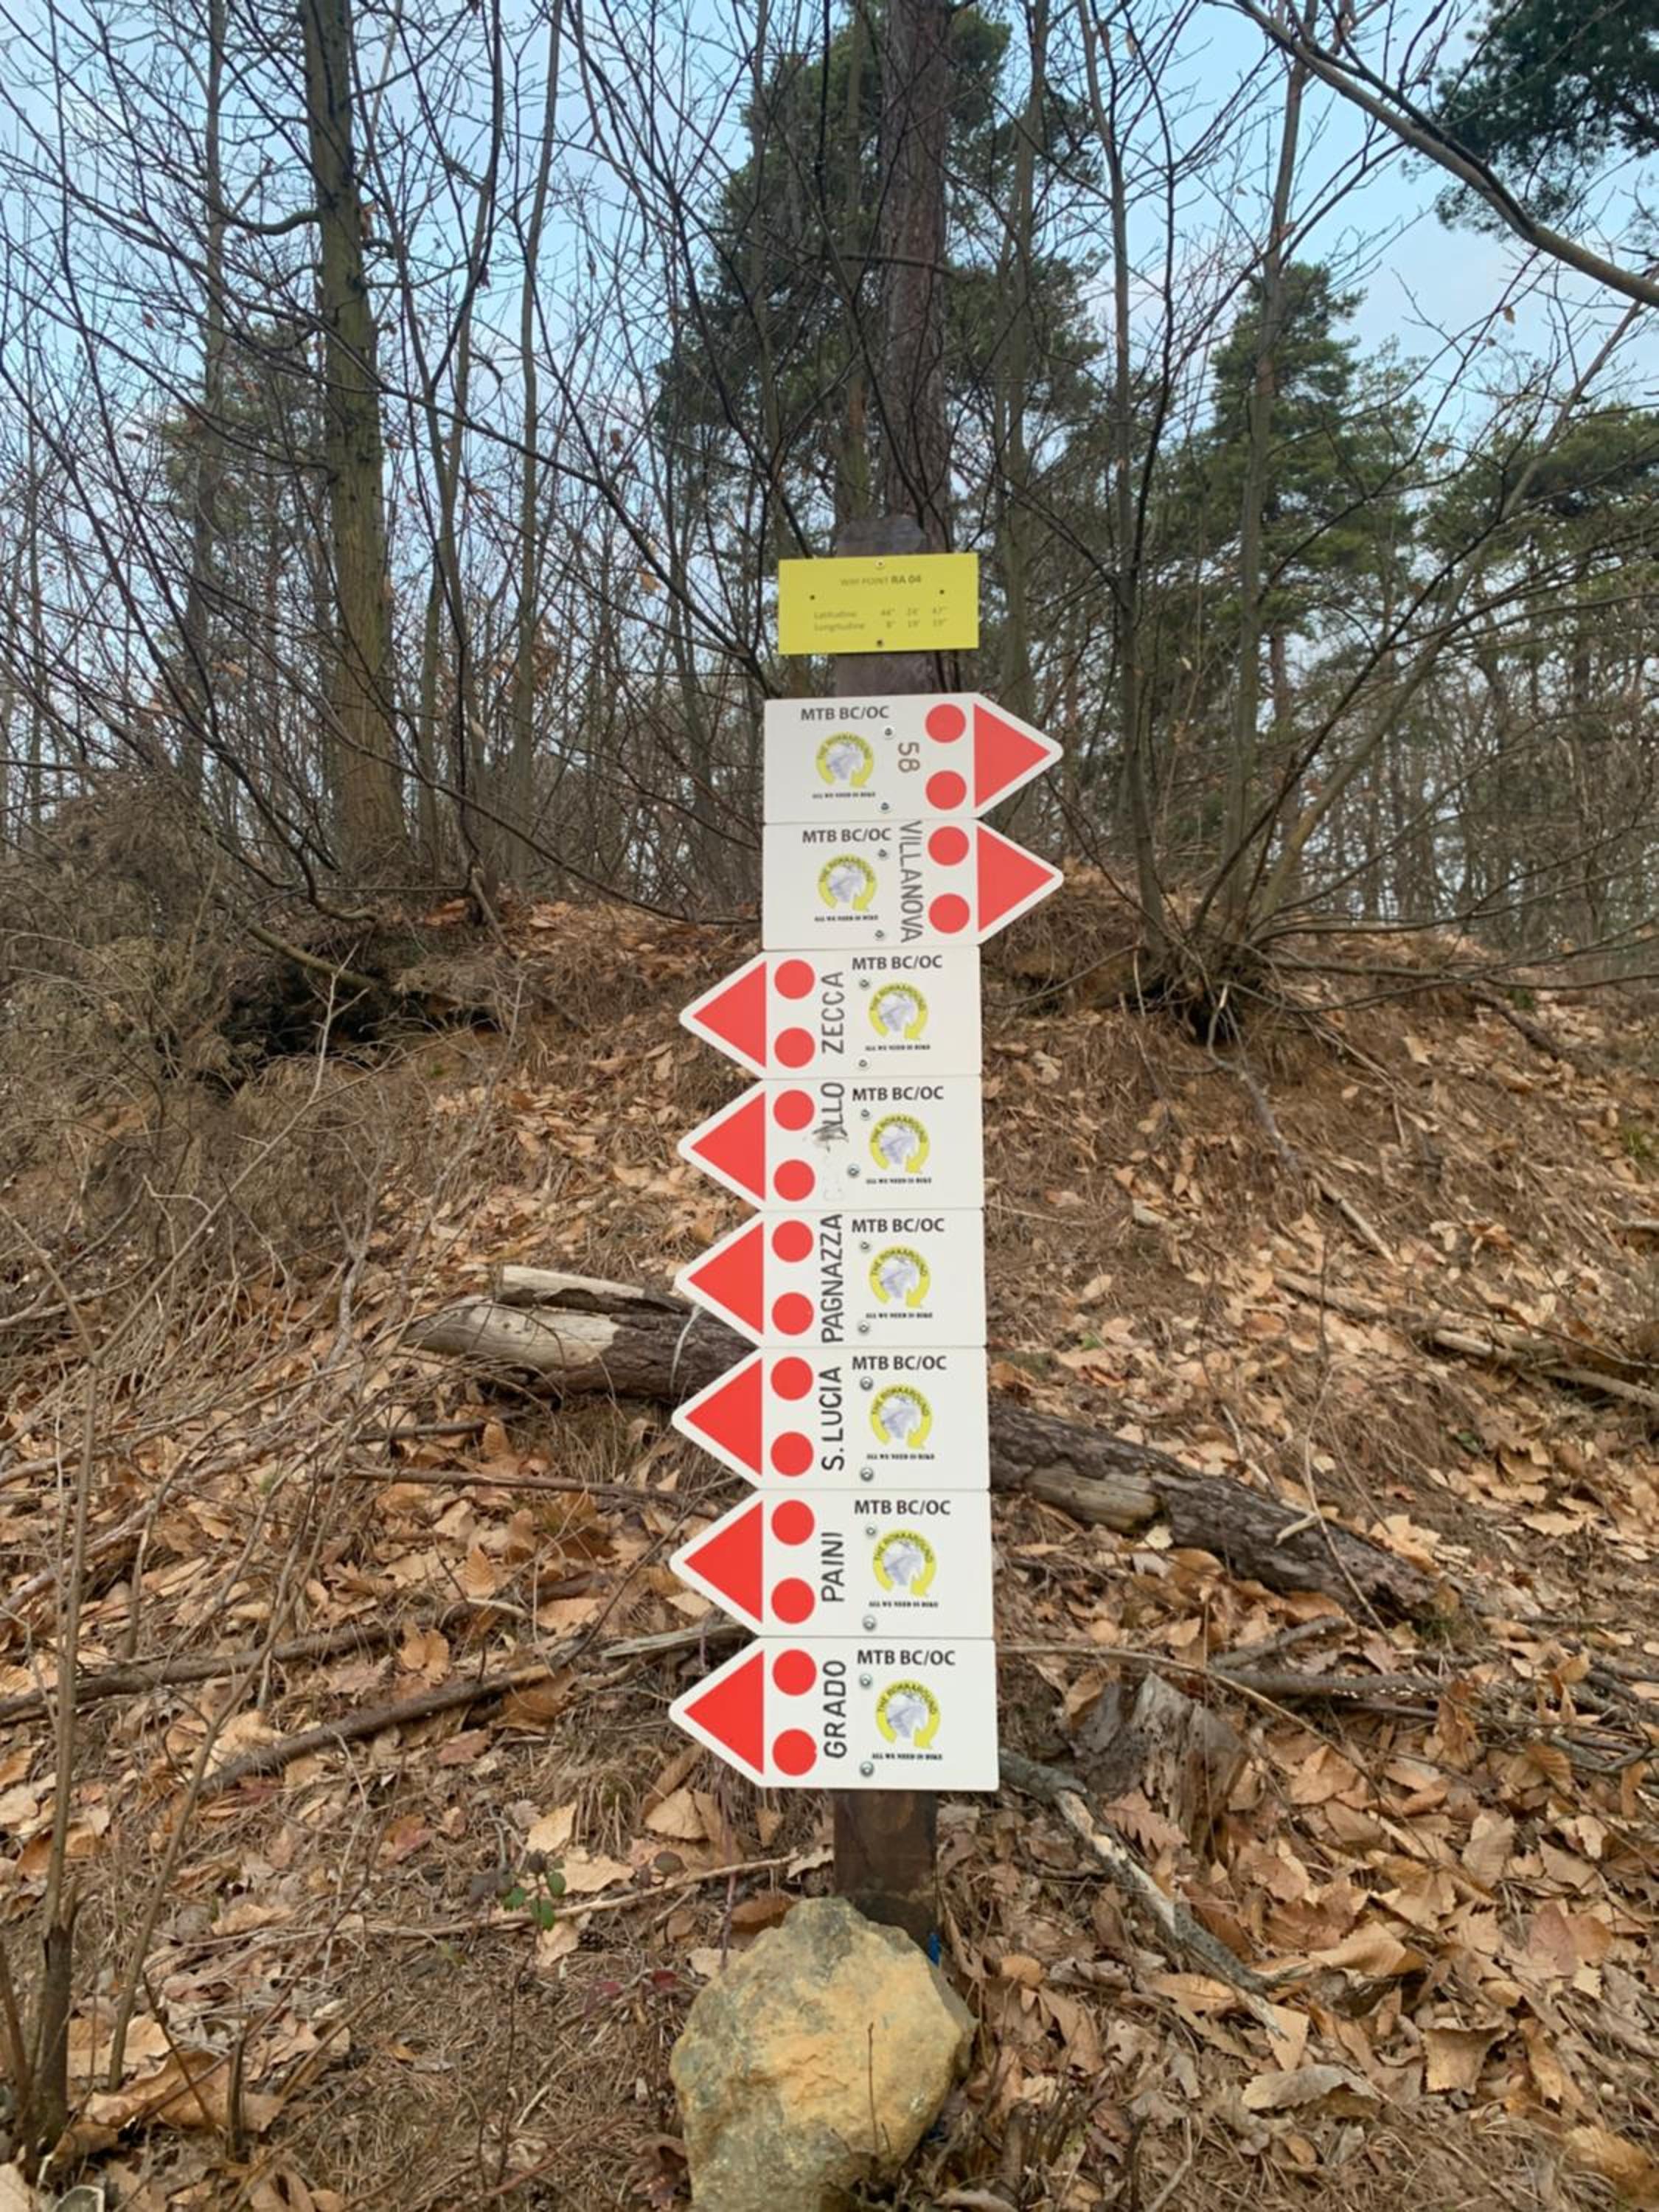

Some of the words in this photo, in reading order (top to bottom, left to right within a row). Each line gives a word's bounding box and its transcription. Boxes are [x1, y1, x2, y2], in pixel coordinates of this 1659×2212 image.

[861, 577, 888, 585] POINT
[891, 575, 906, 584] RA
[908, 574, 922, 584] 04
[800, 708, 835, 721] MTB
[839, 706, 889, 720] BC/OC
[897, 742, 920, 773] 58
[802, 830, 837, 844] MTB
[841, 828, 891, 842] BC/OC
[900, 821, 924, 943] VILLANOVA
[852, 957, 887, 970] MTB
[891, 955, 942, 969] BC/OC
[821, 971, 845, 1054] ZECCA
[852, 1088, 888, 1101] MTB
[892, 1086, 944, 1100] BC/OC
[852, 1219, 887, 1233] MTB
[893, 1218, 945, 1232] BC/OC
[820, 1214, 844, 1343] PAGNAZZA
[852, 1356, 888, 1370] MTB
[894, 1356, 947, 1370] BC/OC
[818, 1366, 844, 1471] S.LUCIA
[855, 1500, 891, 1514] MTB
[897, 1500, 951, 1515] BC/OC
[821, 1531, 845, 1602] PAINI
[857, 1649, 895, 1665] MTB
[900, 1650, 956, 1666] BC/OC
[823, 1660, 847, 1759] GRADO
